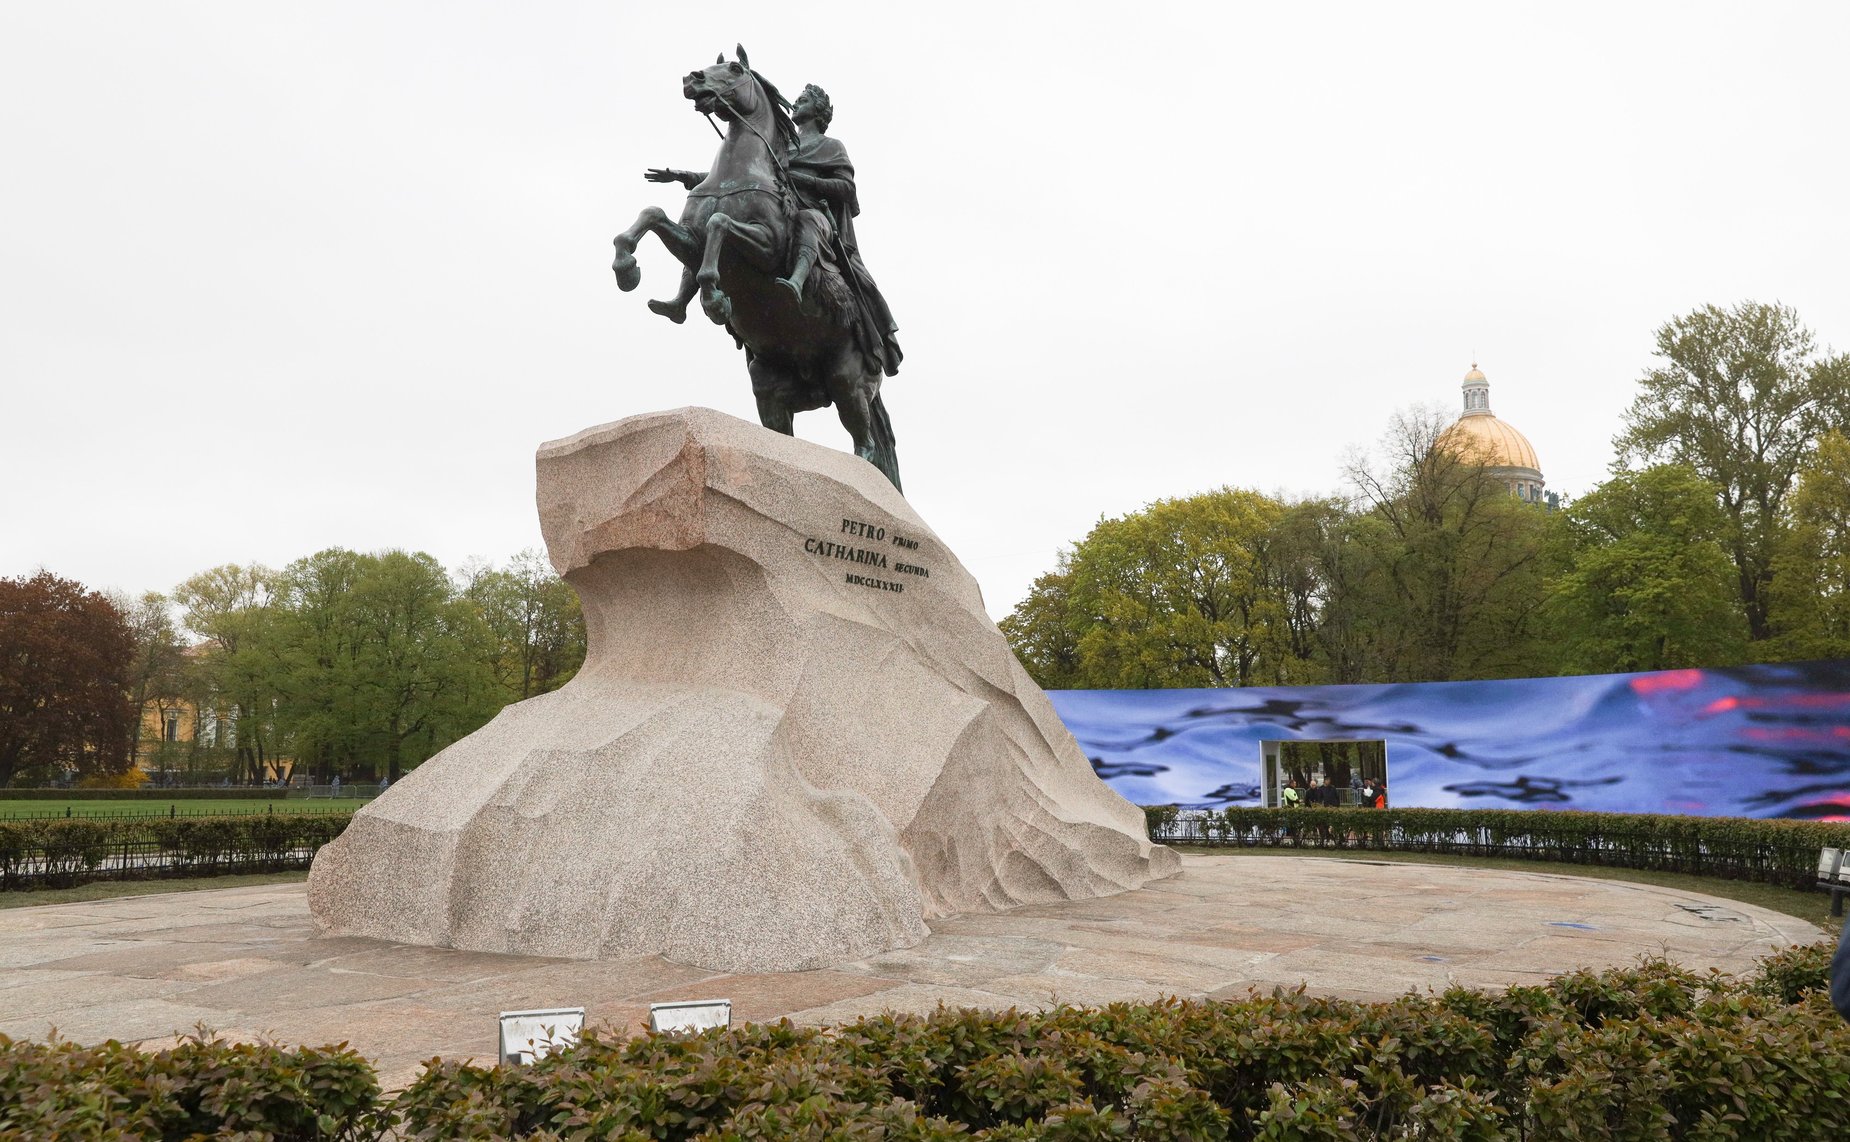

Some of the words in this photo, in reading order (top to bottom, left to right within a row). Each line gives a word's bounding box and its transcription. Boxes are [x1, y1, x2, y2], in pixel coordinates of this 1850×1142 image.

[841, 519, 885, 540] PETRO
[893, 536, 919, 550] PRIMO
[804, 538, 887, 568] CATHARINA
[895, 563, 929, 578] SECUNDA
